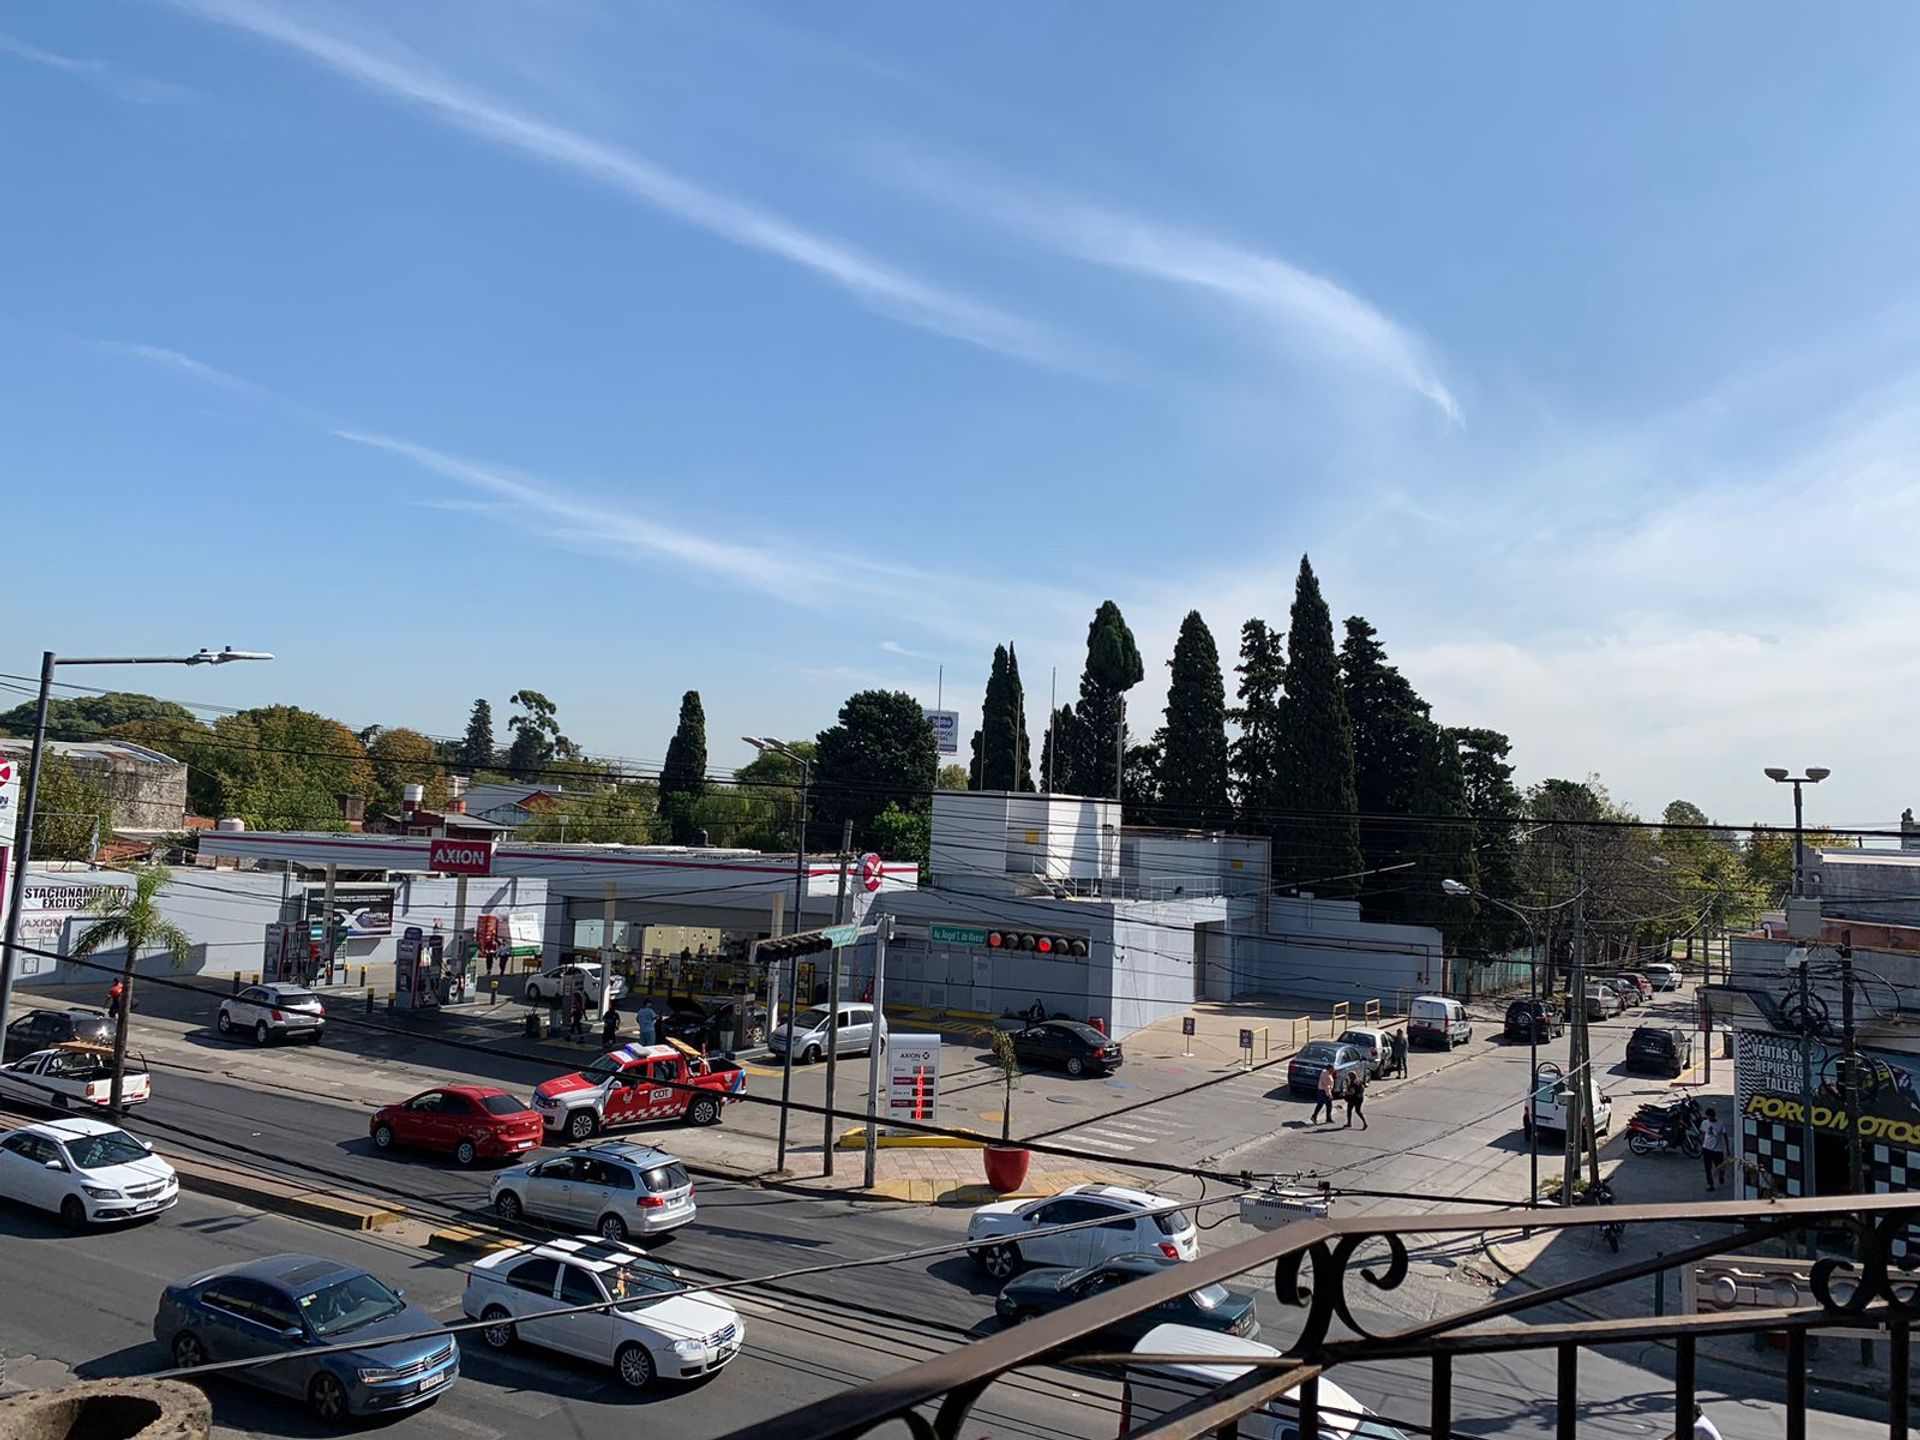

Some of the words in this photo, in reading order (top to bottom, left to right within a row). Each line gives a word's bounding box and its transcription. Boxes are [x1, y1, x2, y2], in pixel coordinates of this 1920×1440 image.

[433, 848, 485, 865] AXION
[42, 898, 93, 909] EXCLUSI
[23, 918, 62, 930] AXION
[1752, 1043, 1789, 1061] VENTAS
[1755, 1060, 1805, 1079] REPUESTO
[1765, 1076, 1801, 1095] TALLER
